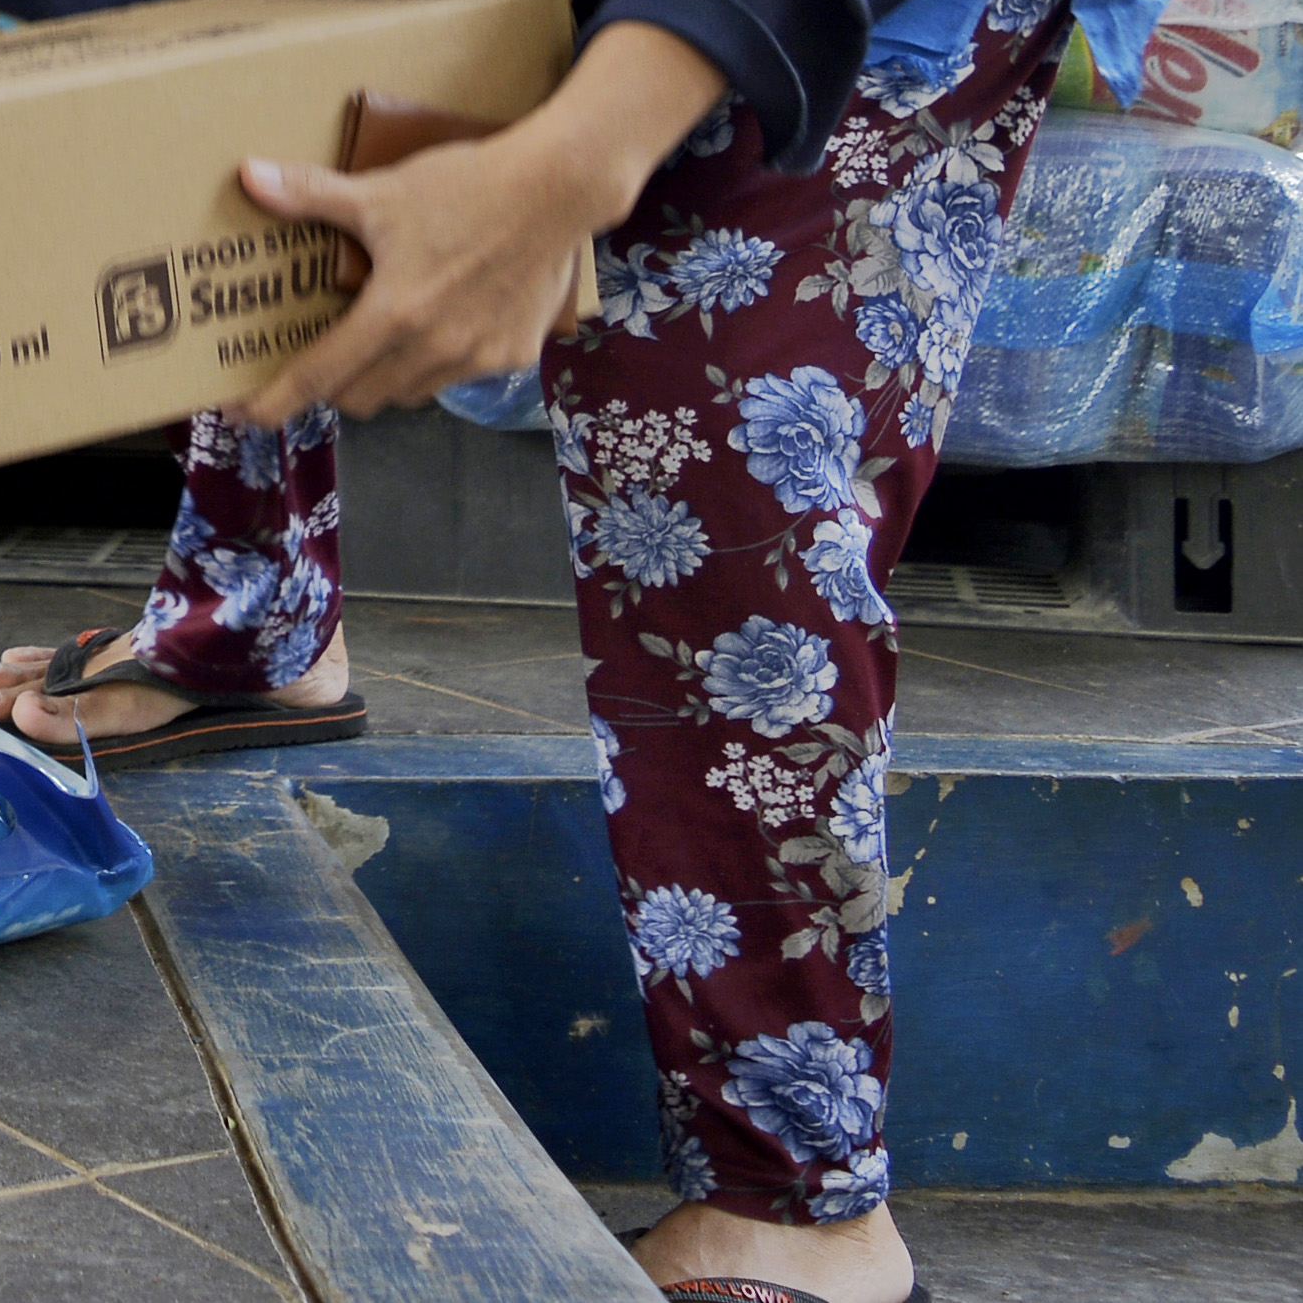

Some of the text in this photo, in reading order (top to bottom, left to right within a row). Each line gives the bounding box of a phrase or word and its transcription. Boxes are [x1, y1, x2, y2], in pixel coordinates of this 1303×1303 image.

[182, 232, 257, 275] FOOD
[191, 270, 283, 326] Susu
[10, 324, 50, 367] ml
